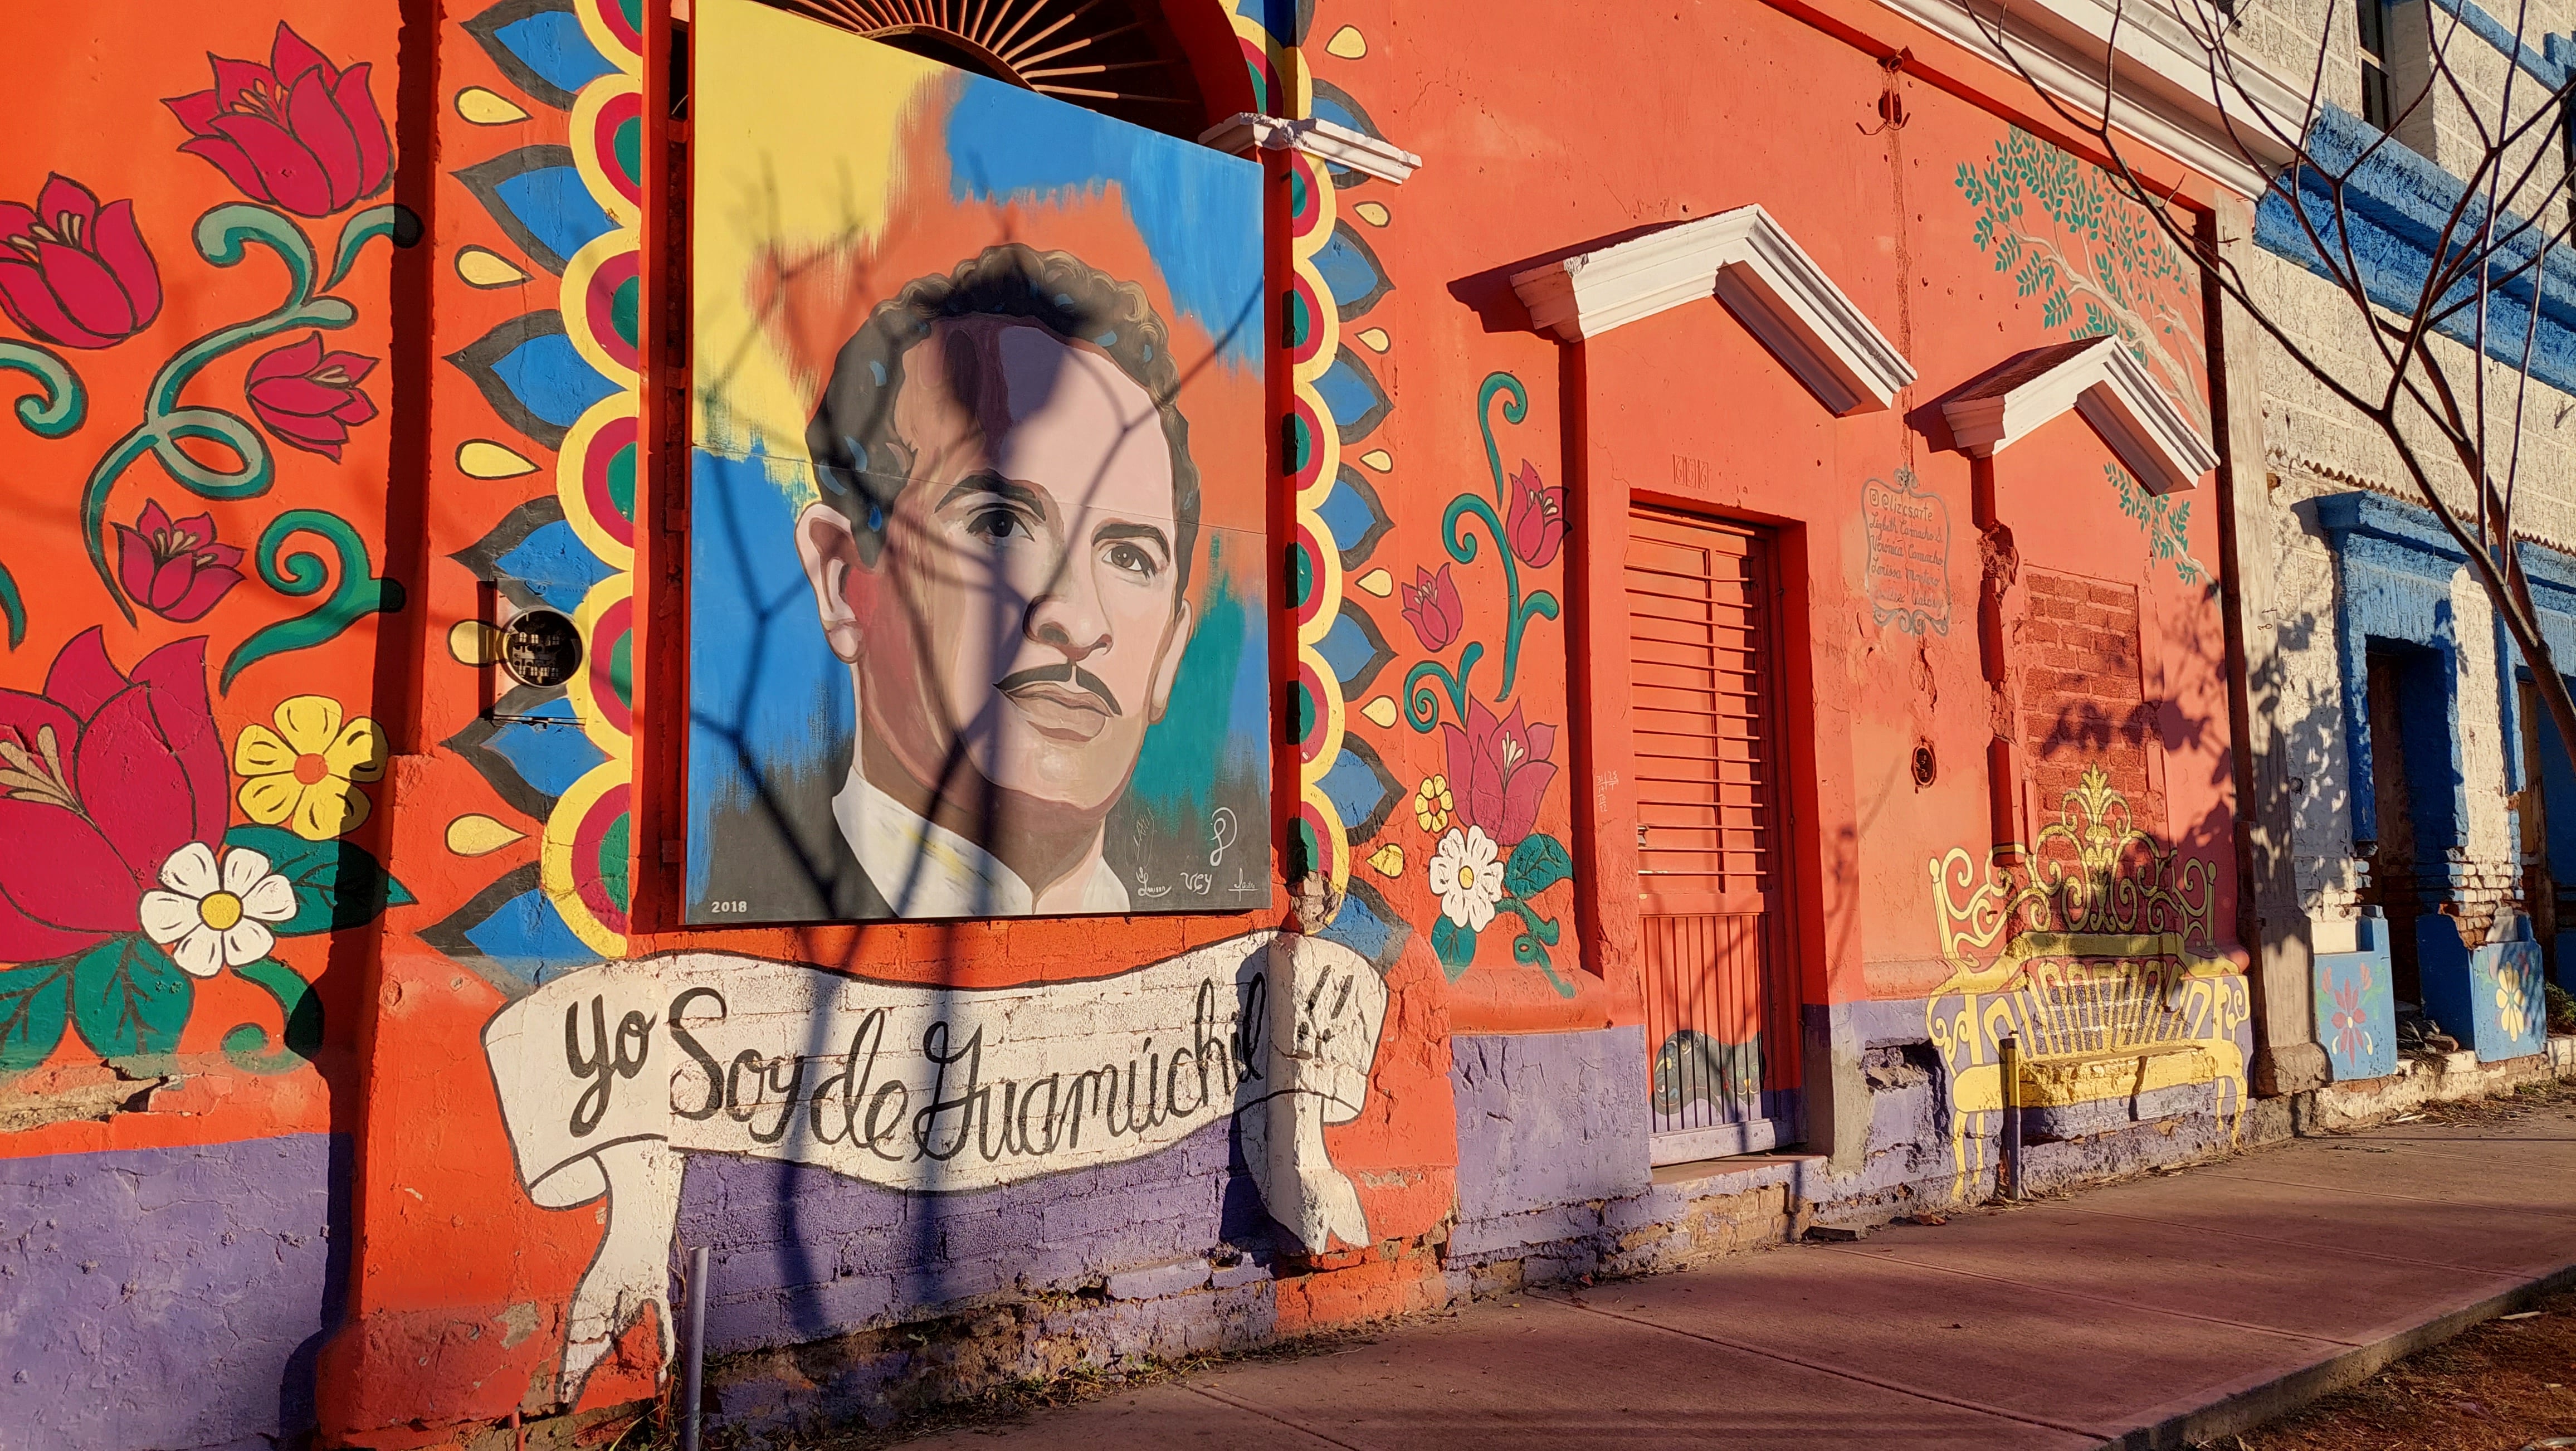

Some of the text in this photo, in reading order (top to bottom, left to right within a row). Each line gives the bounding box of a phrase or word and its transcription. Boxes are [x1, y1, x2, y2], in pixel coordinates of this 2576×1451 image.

[1672, 455, 1709, 490] 656
[1881, 493, 1933, 522] @lizcs.arte
[1900, 519, 1934, 541] Camacho
[1869, 534, 1944, 566] Verónica Camacho
[711, 900, 748, 913] 2018
[669, 987, 805, 1145] Soy
[809, 1006, 909, 1162] de
[910, 971, 1266, 1163] Guamúchil
